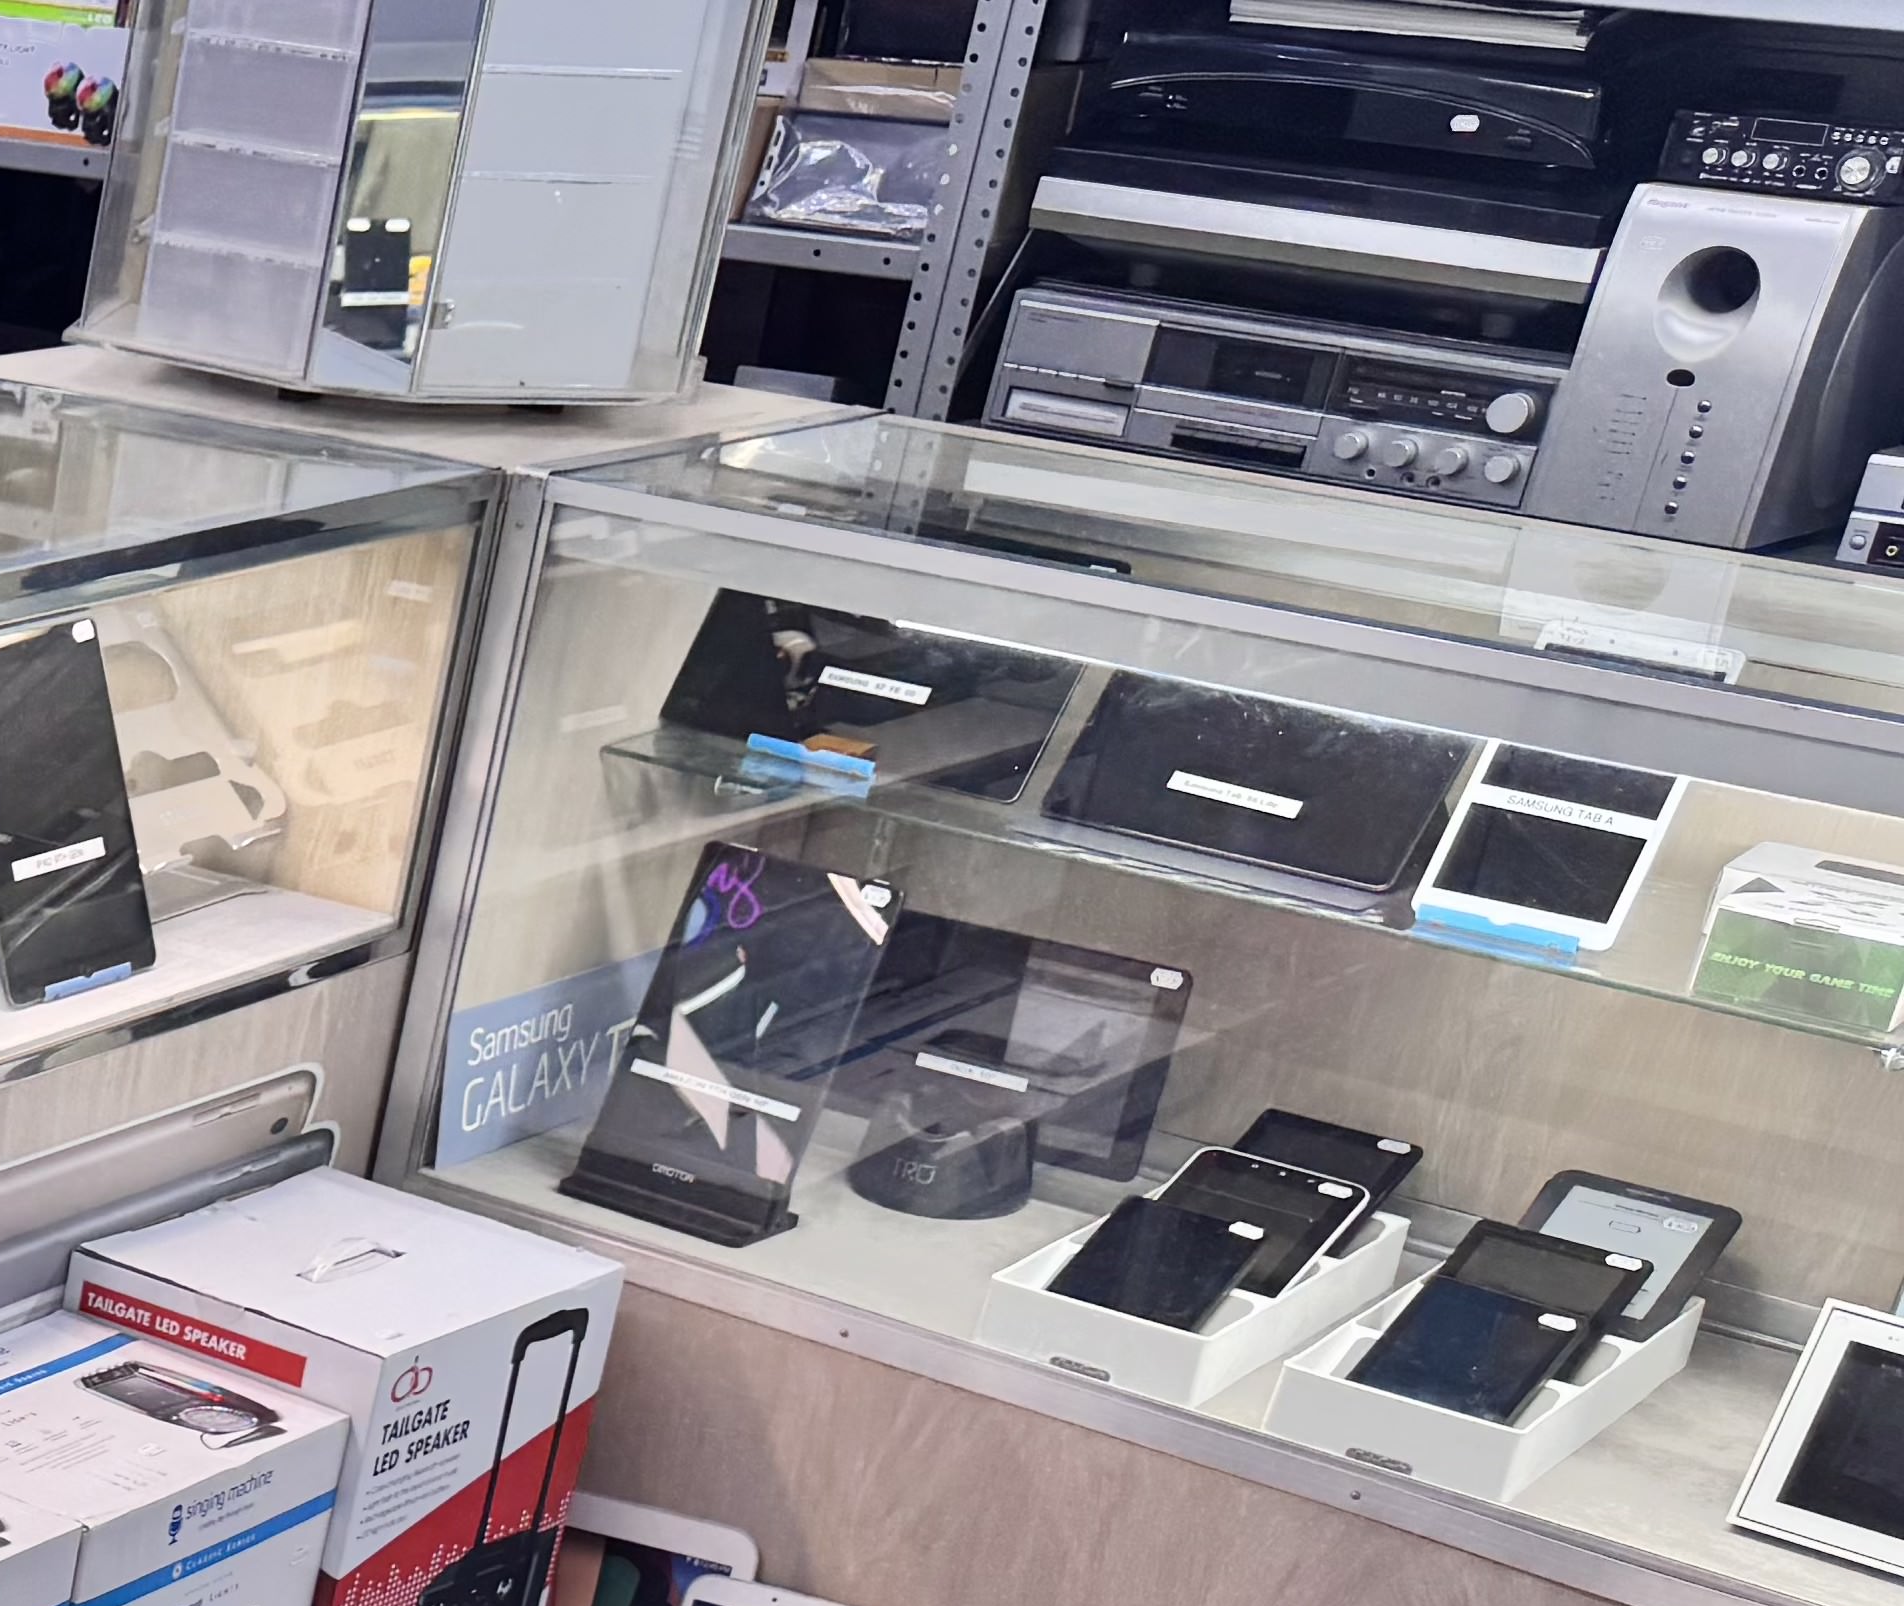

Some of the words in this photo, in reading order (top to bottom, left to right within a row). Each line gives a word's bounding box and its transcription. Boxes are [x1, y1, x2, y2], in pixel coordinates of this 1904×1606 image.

[1506, 794, 1574, 820] SAMSUNG
[1576, 808, 1603, 825] TAB
[1603, 815, 1616, 827] A
[1708, 950, 1758, 970] ENJOY
[1762, 960, 1806, 981] YOUR
[1808, 969, 1856, 991] GAME
[467, 1001, 574, 1069] Samsung
[458, 1036, 602, 1132] GALAXY
[86, 1290, 152, 1331] TAILGATE
[153, 1315, 182, 1338] LED
[182, 1323, 248, 1362] SPEAKER
[372, 1449, 400, 1477] LED
[404, 1419, 471, 1464] SPEAKER
[381, 1399, 451, 1446] TAILGATE
[185, 1490, 226, 1521] singing
[227, 1470, 275, 1502] machine
